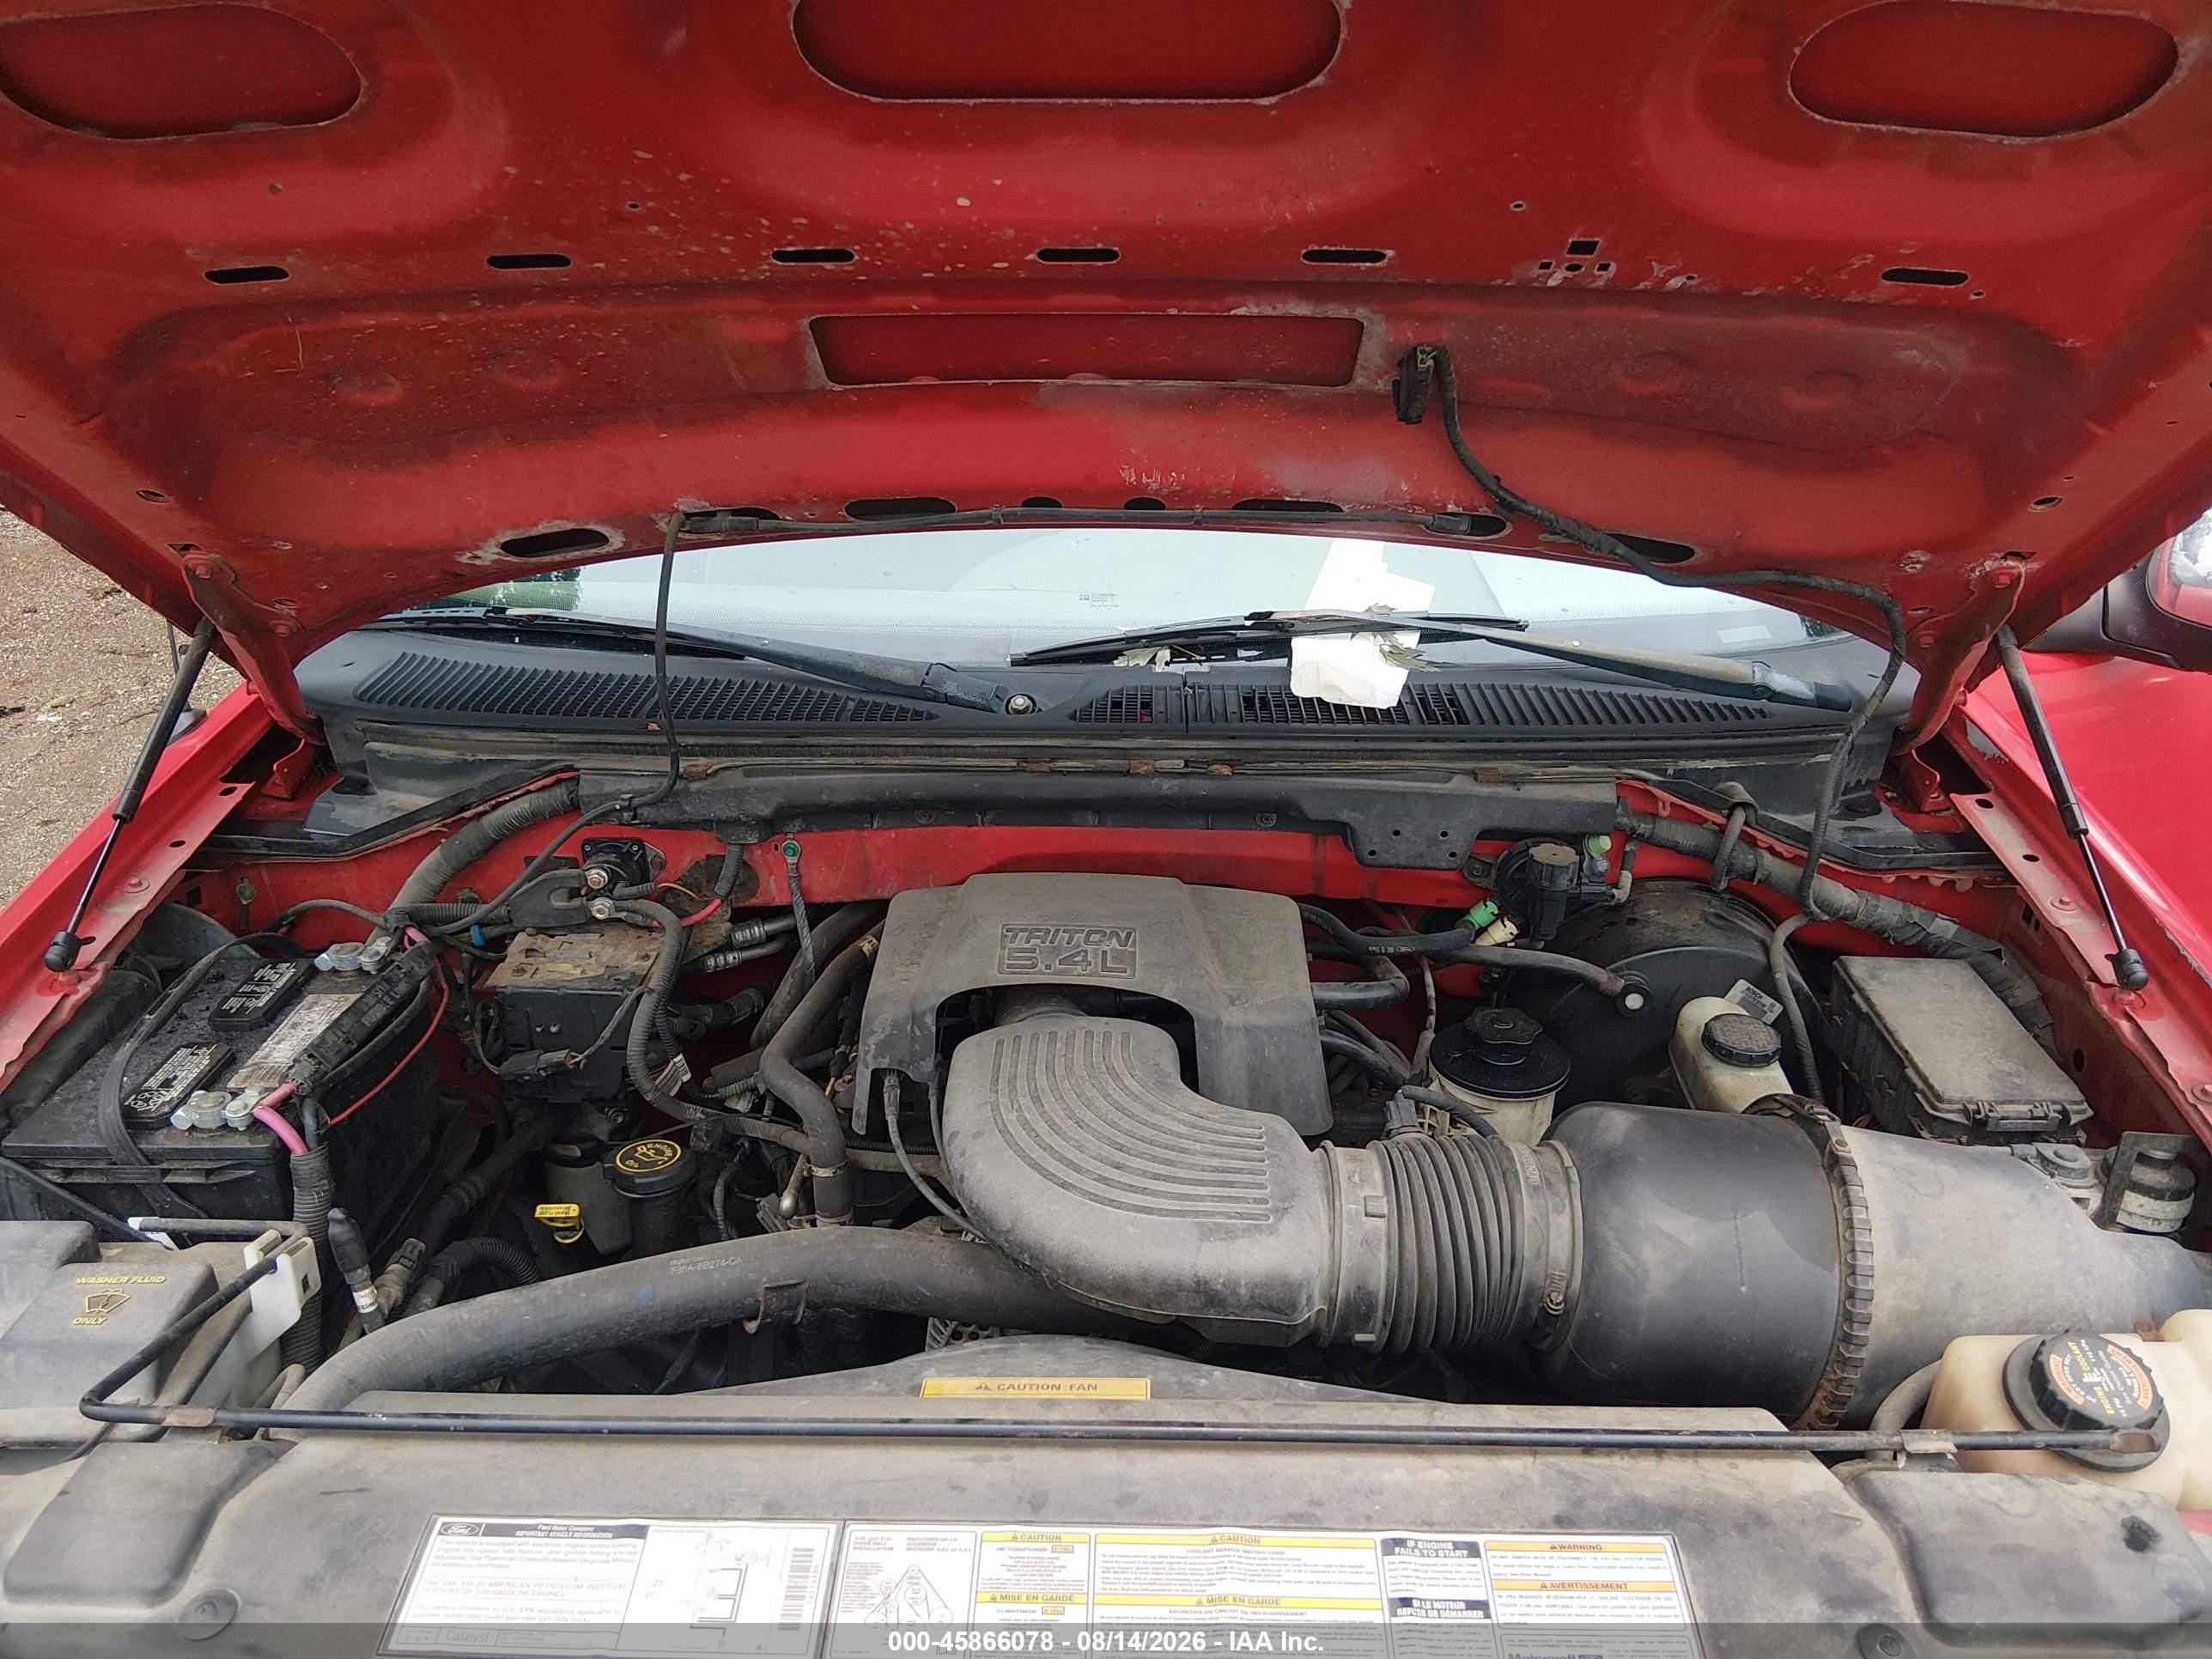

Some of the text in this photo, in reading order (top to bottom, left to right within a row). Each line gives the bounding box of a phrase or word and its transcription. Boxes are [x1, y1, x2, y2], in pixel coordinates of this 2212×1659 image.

[1005, 927, 1133, 947] TRITON
[1745, 986, 1763, 1000] BOSCH
[647, 1143, 673, 1158] ENGINE
[624, 1159, 640, 1168] OIL
[76, 1275, 167, 1285] WASHER FLUID
[72, 1316, 107, 1326] ONLY
[2067, 1341, 2116, 1415] ENGINE COOLANT
[2071, 1382, 2087, 1395] NOT
[447, 1525, 471, 1534] Ford
[1219, 1534, 1261, 1545] CAUTION
[1418, 1540, 1454, 1550] ENGINE
[1395, 1547, 1420, 1556] FAILS
[1438, 1549, 1468, 1558] START
[1206, 1595, 1230, 1604] MISE
[1248, 1597, 1282, 1606] GARDE
[1412, 1599, 1466, 1610] SI LE MOTEUR
[1397, 1607, 1426, 1616] REFUSE
[446, 1630, 489, 1643] Catalyst
